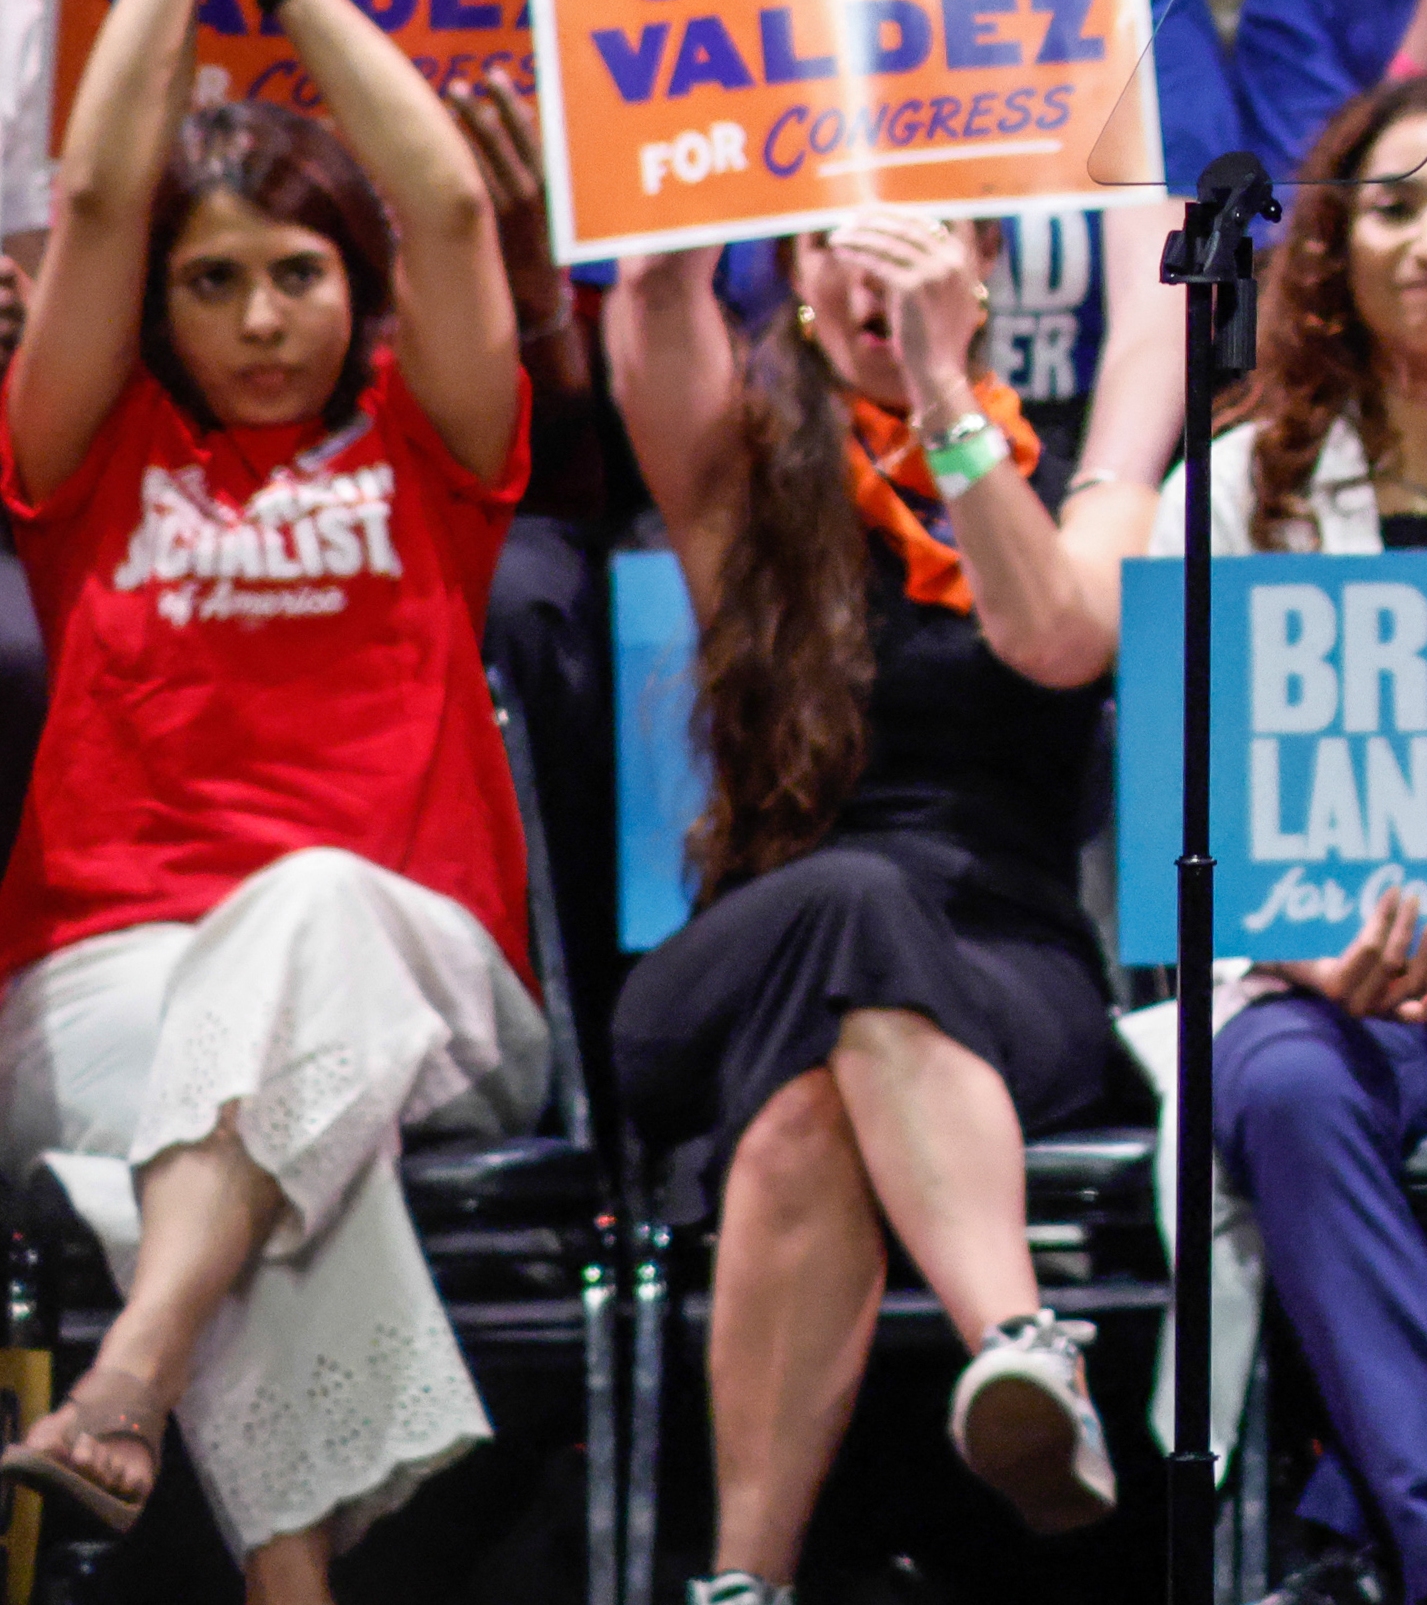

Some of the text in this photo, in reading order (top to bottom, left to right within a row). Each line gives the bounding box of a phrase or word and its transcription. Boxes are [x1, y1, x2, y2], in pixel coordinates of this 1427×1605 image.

[639, 84, 1074, 196] FOR CONGRESS
[1243, 865, 1355, 932] for
